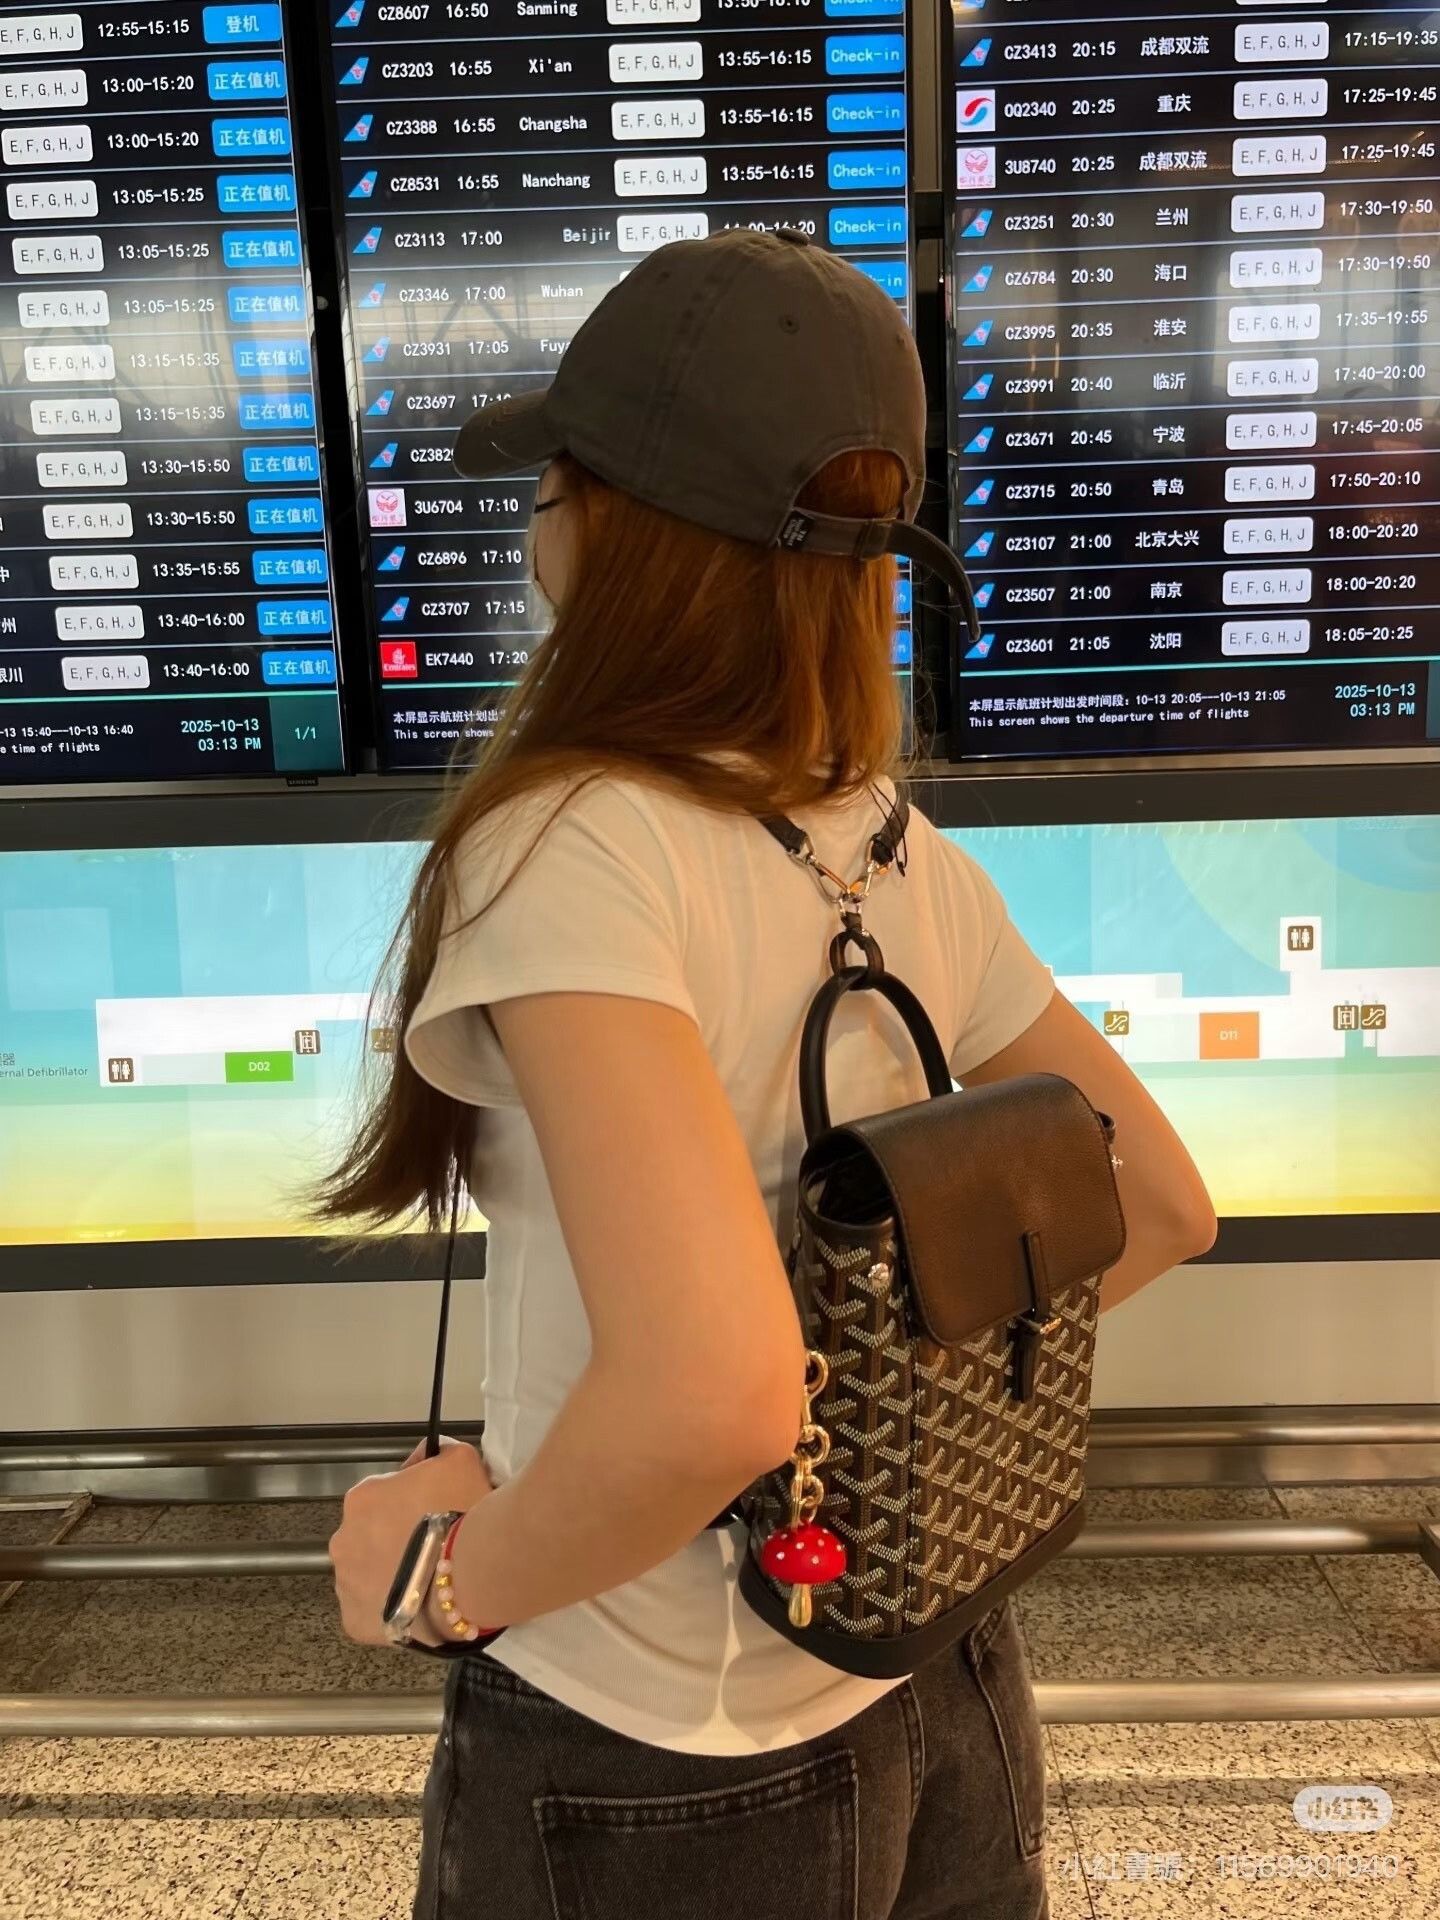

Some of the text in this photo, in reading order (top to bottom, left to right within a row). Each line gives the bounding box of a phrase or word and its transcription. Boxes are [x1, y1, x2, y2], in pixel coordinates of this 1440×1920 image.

[378, 2, 578, 21] CZ8607 16:50 Sanming
[97, 15, 260, 38] 12:55-15:15 登机
[1004, 44, 1057, 60] CZ3413
[1072, 41, 1116, 57] 20:15
[1140, 36, 1210, 57] 成都双流
[1344, 30, 1438, 46] 17:15-19:35
[382, 49, 900, 78] CZ3203 16:55 Xi'an 13:55-16:15 Check-in
[102, 75, 194, 94] 13:00-15:20
[214, 72, 280, 90] 正在值机
[1072, 99, 1116, 115] 20:25
[1157, 94, 1192, 113] 重庆
[1343, 87, 1437, 103] 17:25-19:45
[386, 120, 437, 135] CZ3388
[453, 118, 496, 133] 16:55
[519, 116, 587, 131] Changsha
[720, 108, 813, 124] 13:55-16:15
[832, 108, 900, 121] Check-in
[107, 128, 285, 149] 13:00-15:20 正在值机
[1004, 143, 1435, 174] 3U8740 20:25 成都双流 17:25-19:45
[390, 165, 901, 192] CZ8531 16:55 Nanchang 13:55-16:15 Check-in
[112, 187, 204, 205] 13:05-15:25
[224, 185, 290, 202] 正在值机
[1004, 216, 1055, 231] CZ3251
[1071, 213, 1114, 228] 20:30
[1155, 208, 1189, 226] 兰州
[1340, 199, 1433, 216] 17:30-19:50
[394, 233, 445, 248] CZ3113
[461, 232, 503, 245] 17:00
[834, 222, 901, 235] Check-in
[118, 242, 295, 259] 13:05-15:25 正在值机
[1005, 255, 1431, 285] CZ6784 20:30 海口 17:30-19:50
[399, 285, 584, 303] CZ3346 17:00 Wuhan
[124, 296, 300, 314] 13:05-15:25 正在值机
[1005, 310, 1428, 340] CZ3995 20:35 淮安 17:35-19:55
[403, 340, 509, 357] CZ3931 17:05
[130, 350, 305, 368] 13:15-15:35 正在值机
[1005, 364, 1426, 394] CZ3991 20:40 临沂 17:40-20:00
[135, 403, 309, 421] 13:15-15:35 正在值机
[406, 396, 456, 410] CZ3697
[1005, 432, 1054, 447] CZ3671
[1070, 430, 1113, 445] 20:45
[1152, 425, 1185, 444] 宁波
[1332, 418, 1423, 435] 17:45-20:05
[141, 459, 230, 475] 13:30-15:50
[249, 456, 314, 473] 正在值机
[1005, 471, 1421, 499] CZ3715 20:50 青岛 17:50-20:10
[414, 499, 519, 515] 3U6704 17:10
[146, 509, 319, 526] 13:30-15:50 正在值机
[1006, 524, 1419, 551] CZ3107 21:00 北京大兴 18:00-20:20
[418, 550, 522, 566] CZ6896 17:10
[152, 562, 240, 578] 13:35-15:55
[259, 560, 322, 576] 正在值机
[1006, 588, 1055, 602] CZ3507
[1070, 586, 1111, 600] 21:00
[1150, 582, 1183, 599] 南京
[1326, 575, 1416, 591] 18:00-20:20
[421, 601, 525, 616] CZ3707 17:15
[157, 610, 327, 628] 13:40-16:00 正在值机
[1006, 626, 1414, 653] CZ3601 21:05 沈阳 18:05-20:25
[425, 652, 529, 666] EK7440 17:20
[163, 663, 250, 677] 13:40-16:00
[268, 660, 331, 676] 正在值机
[1255, 690, 1286, 701] 21:05
[1334, 683, 1416, 699] 2025-10-13
[969, 709, 1249, 728] This screen shows the departure time of flights
[1350, 703, 1415, 717] 03:13 PM
[104, 724, 134, 735] 16:40
[181, 719, 260, 734] 2025-10-13
[294, 726, 317, 740] 1/1
[393, 728, 494, 740] This screen shows
[11, 741, 100, 754] time of flights
[198, 737, 261, 751] 03:13 PM
[1219, 1030, 1239, 1041] D11
[248, 1061, 271, 1073] D02
